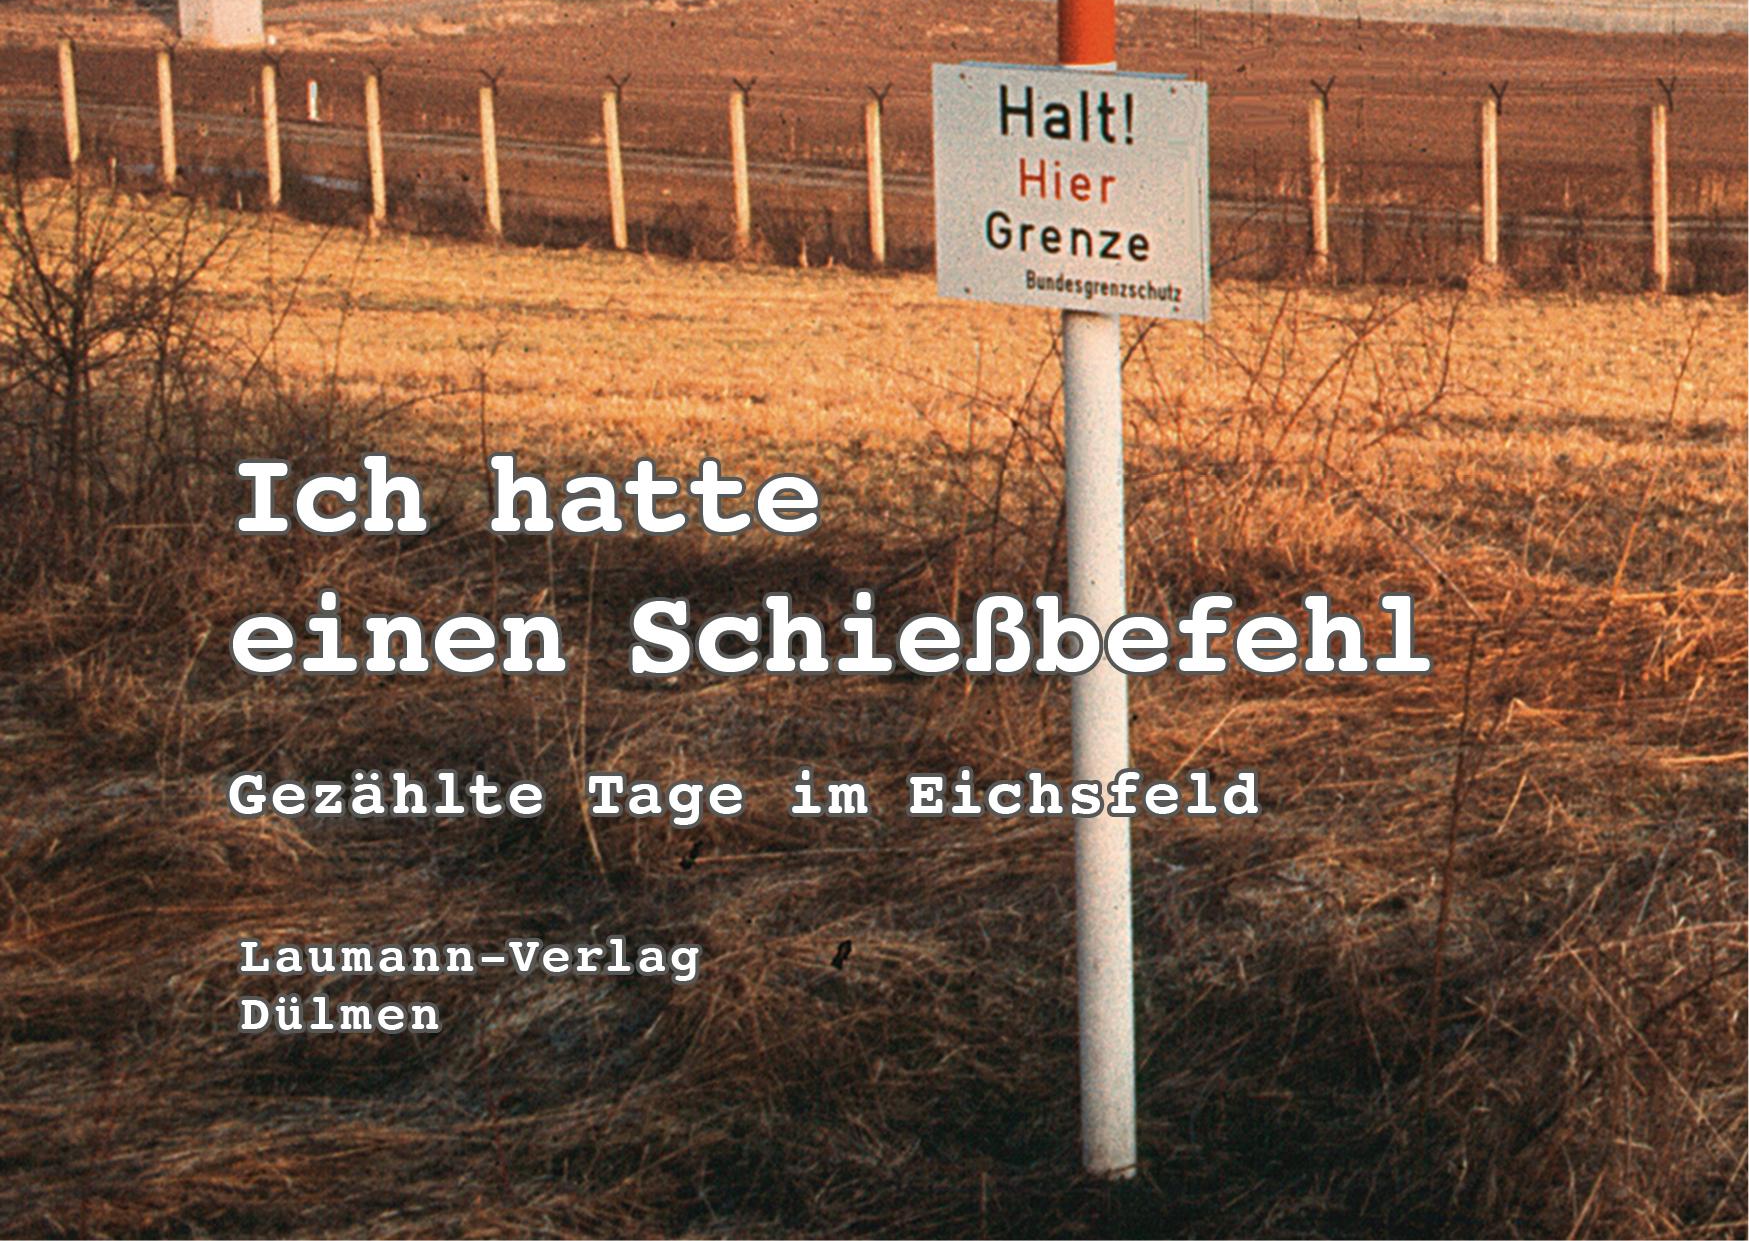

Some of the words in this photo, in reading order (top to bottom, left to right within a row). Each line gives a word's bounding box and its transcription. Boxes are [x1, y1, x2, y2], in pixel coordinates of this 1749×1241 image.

[1000, 84, 1134, 145] Halt!
[1019, 158, 1117, 203] Hier
[985, 211, 1150, 261] Grenze
[1025, 269, 1183, 302] Bundesgrenzschutz
